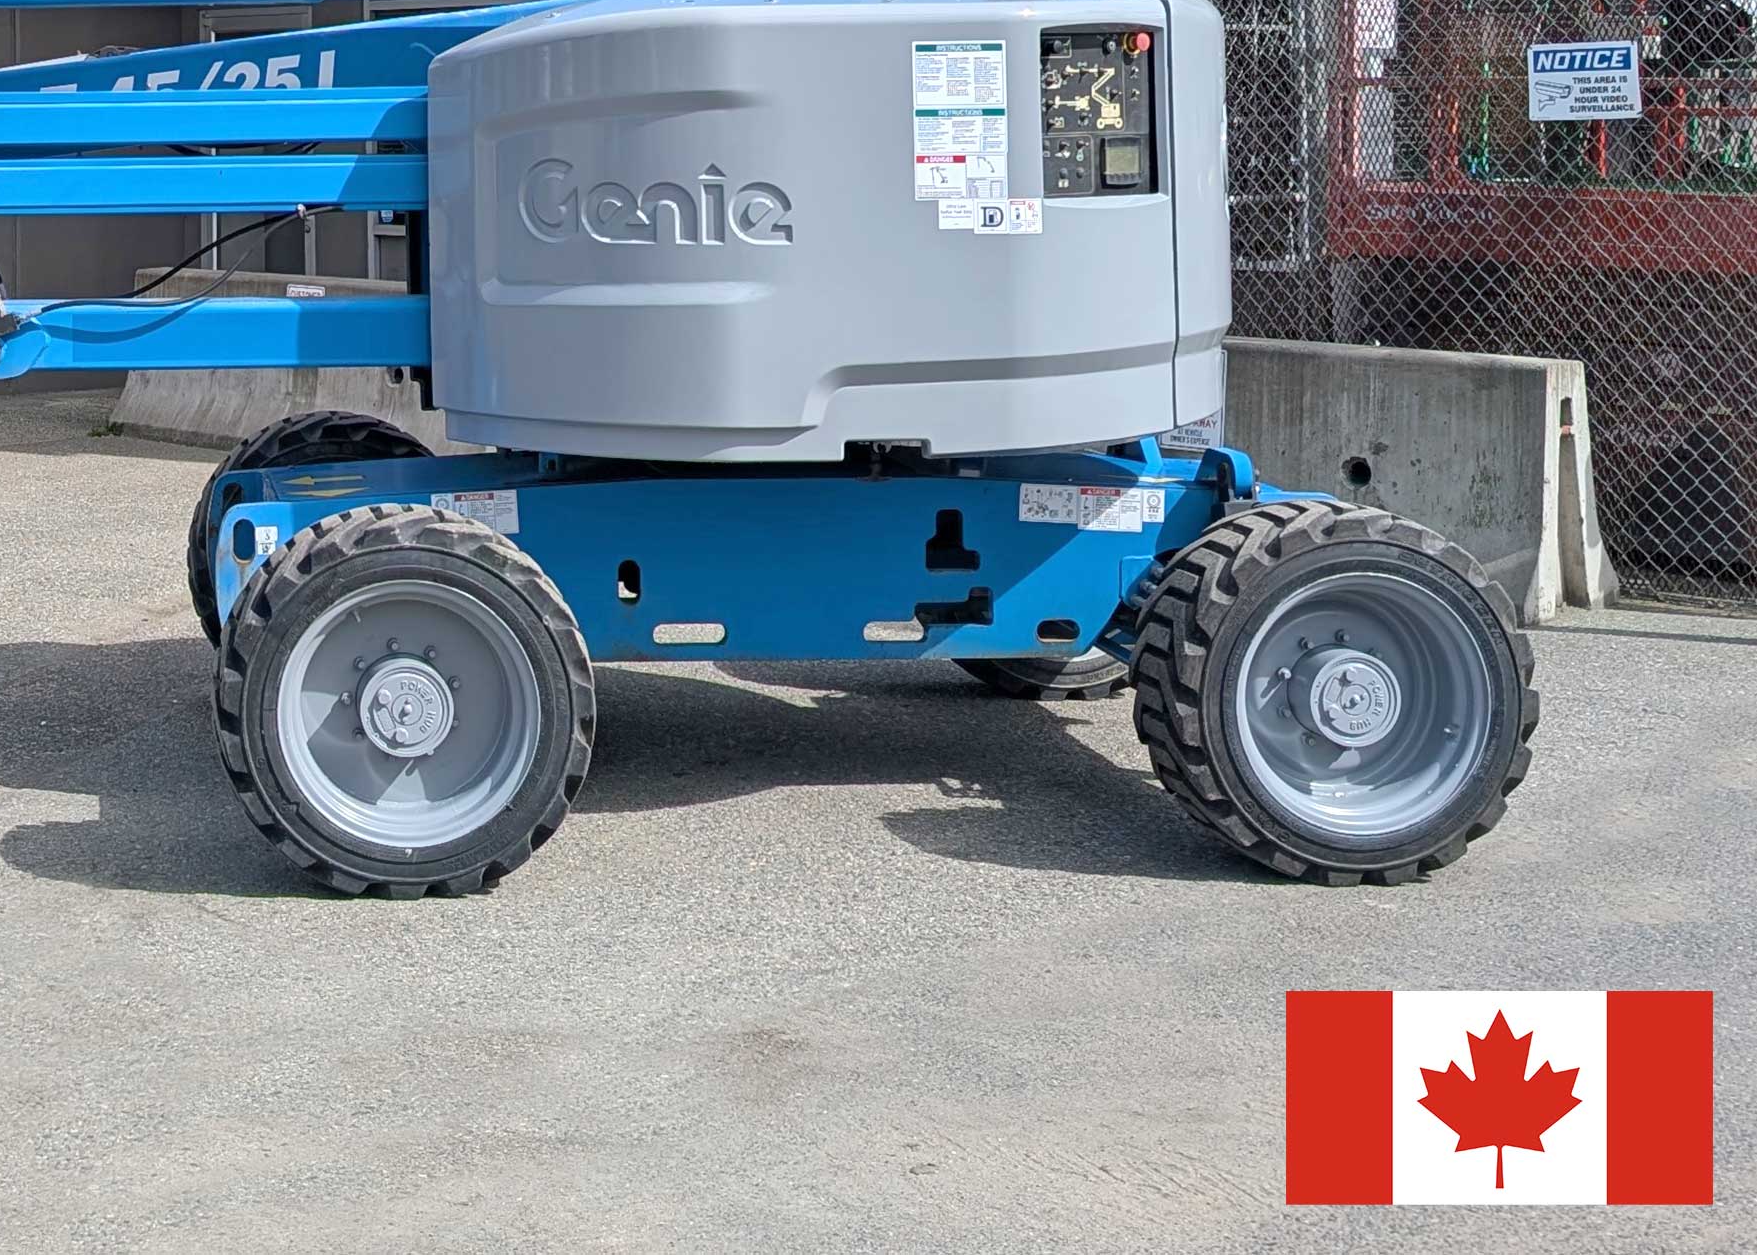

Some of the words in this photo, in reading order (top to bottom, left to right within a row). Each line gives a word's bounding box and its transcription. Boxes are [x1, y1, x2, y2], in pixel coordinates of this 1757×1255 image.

[1537, 49, 1627, 70] NOTICE
[1594, 76, 1616, 84] AREA
[1619, 75, 1628, 83] IS
[1579, 86, 1608, 94] UNDER
[1611, 85, 1621, 93] 24
[1601, 95, 1628, 103] VIDEO
[1569, 104, 1635, 113] SURVEILLANCE
[518, 157, 794, 246] Genie
